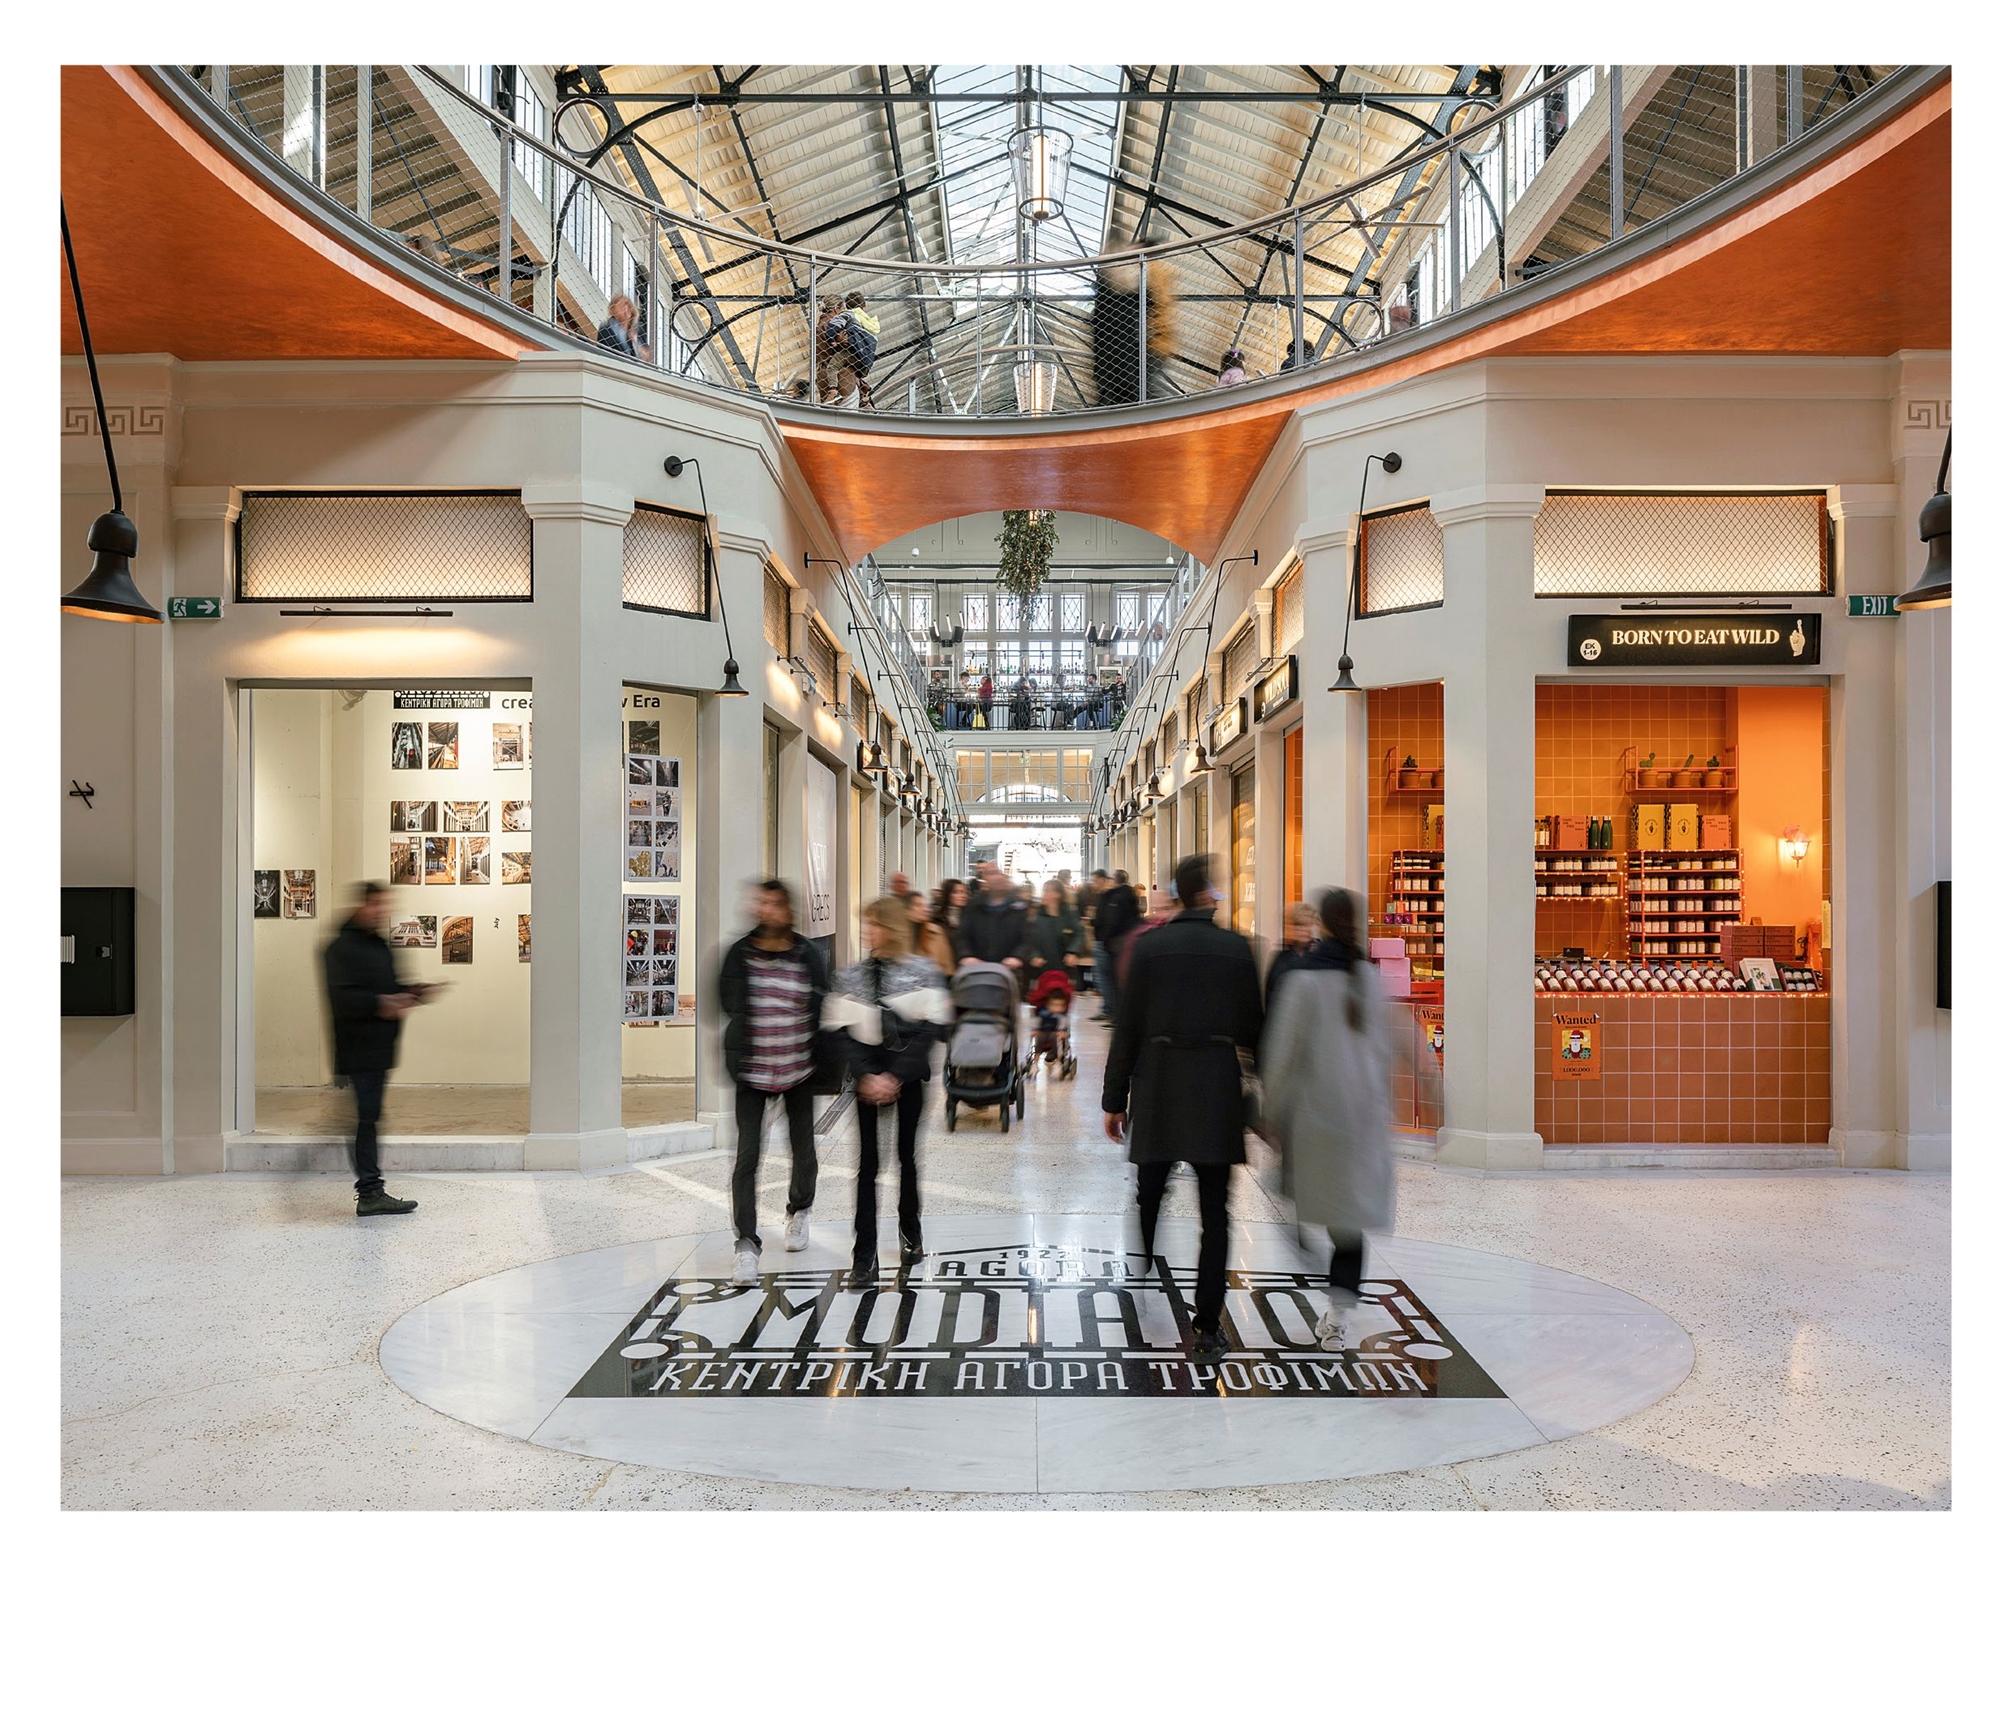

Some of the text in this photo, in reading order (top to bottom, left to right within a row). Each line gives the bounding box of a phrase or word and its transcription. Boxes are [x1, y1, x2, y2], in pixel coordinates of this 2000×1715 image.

[1862, 596, 1888, 615] EXIT
[1611, 630, 1780, 645] BORN TO EAT WILD
[400, 698, 431, 708] ΚΕΝΤΡΙΚΗ
[633, 694, 661, 708] Era
[1556, 1014, 1597, 1025] Wanted
[1000, 1249, 1071, 1259] 1922
[935, 1260, 1134, 1277] AGORA
[649, 1362, 1430, 1391] ΚΕΝΤΡΙΚΗ ΑΓΟΡΑ ΤΡΟΦΙΜΩΝ
